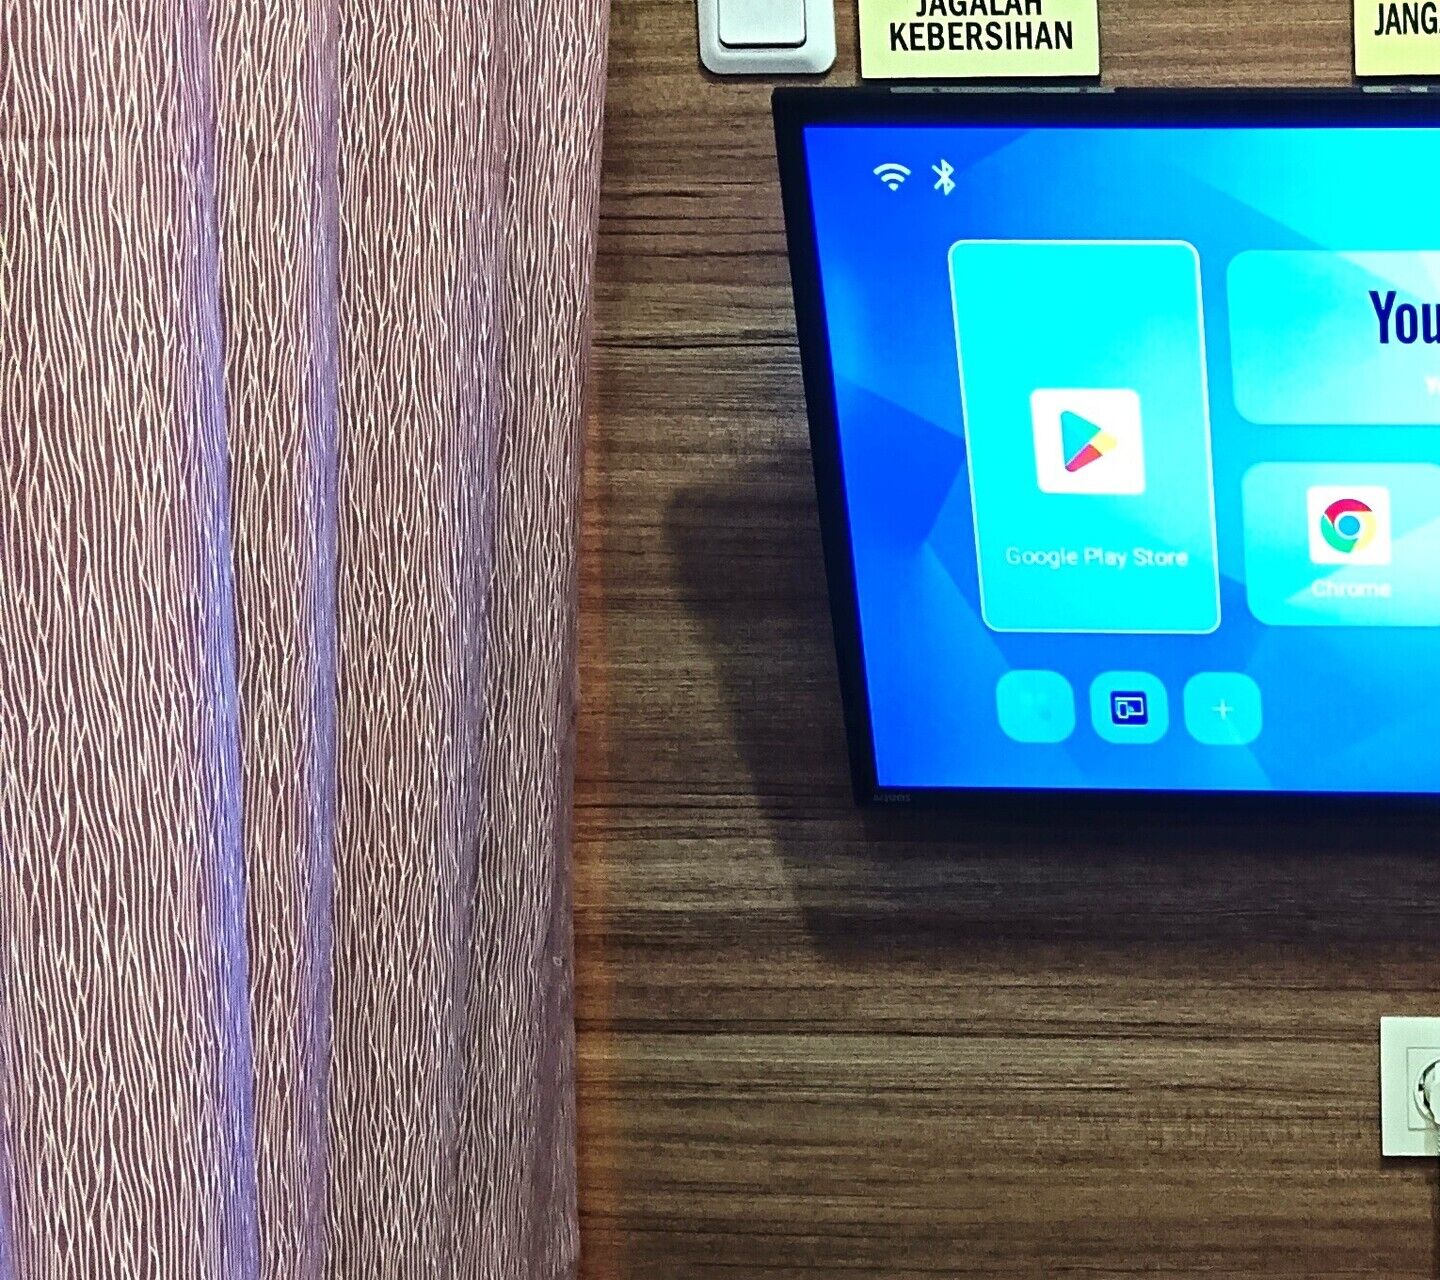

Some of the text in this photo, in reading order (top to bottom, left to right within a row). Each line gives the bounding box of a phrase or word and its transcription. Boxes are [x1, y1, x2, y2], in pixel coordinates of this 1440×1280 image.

[889, 20, 1074, 52] KEBERSIHAN
[1005, 545, 1190, 571] Google Play Store
[1310, 580, 1392, 599] Chrome
